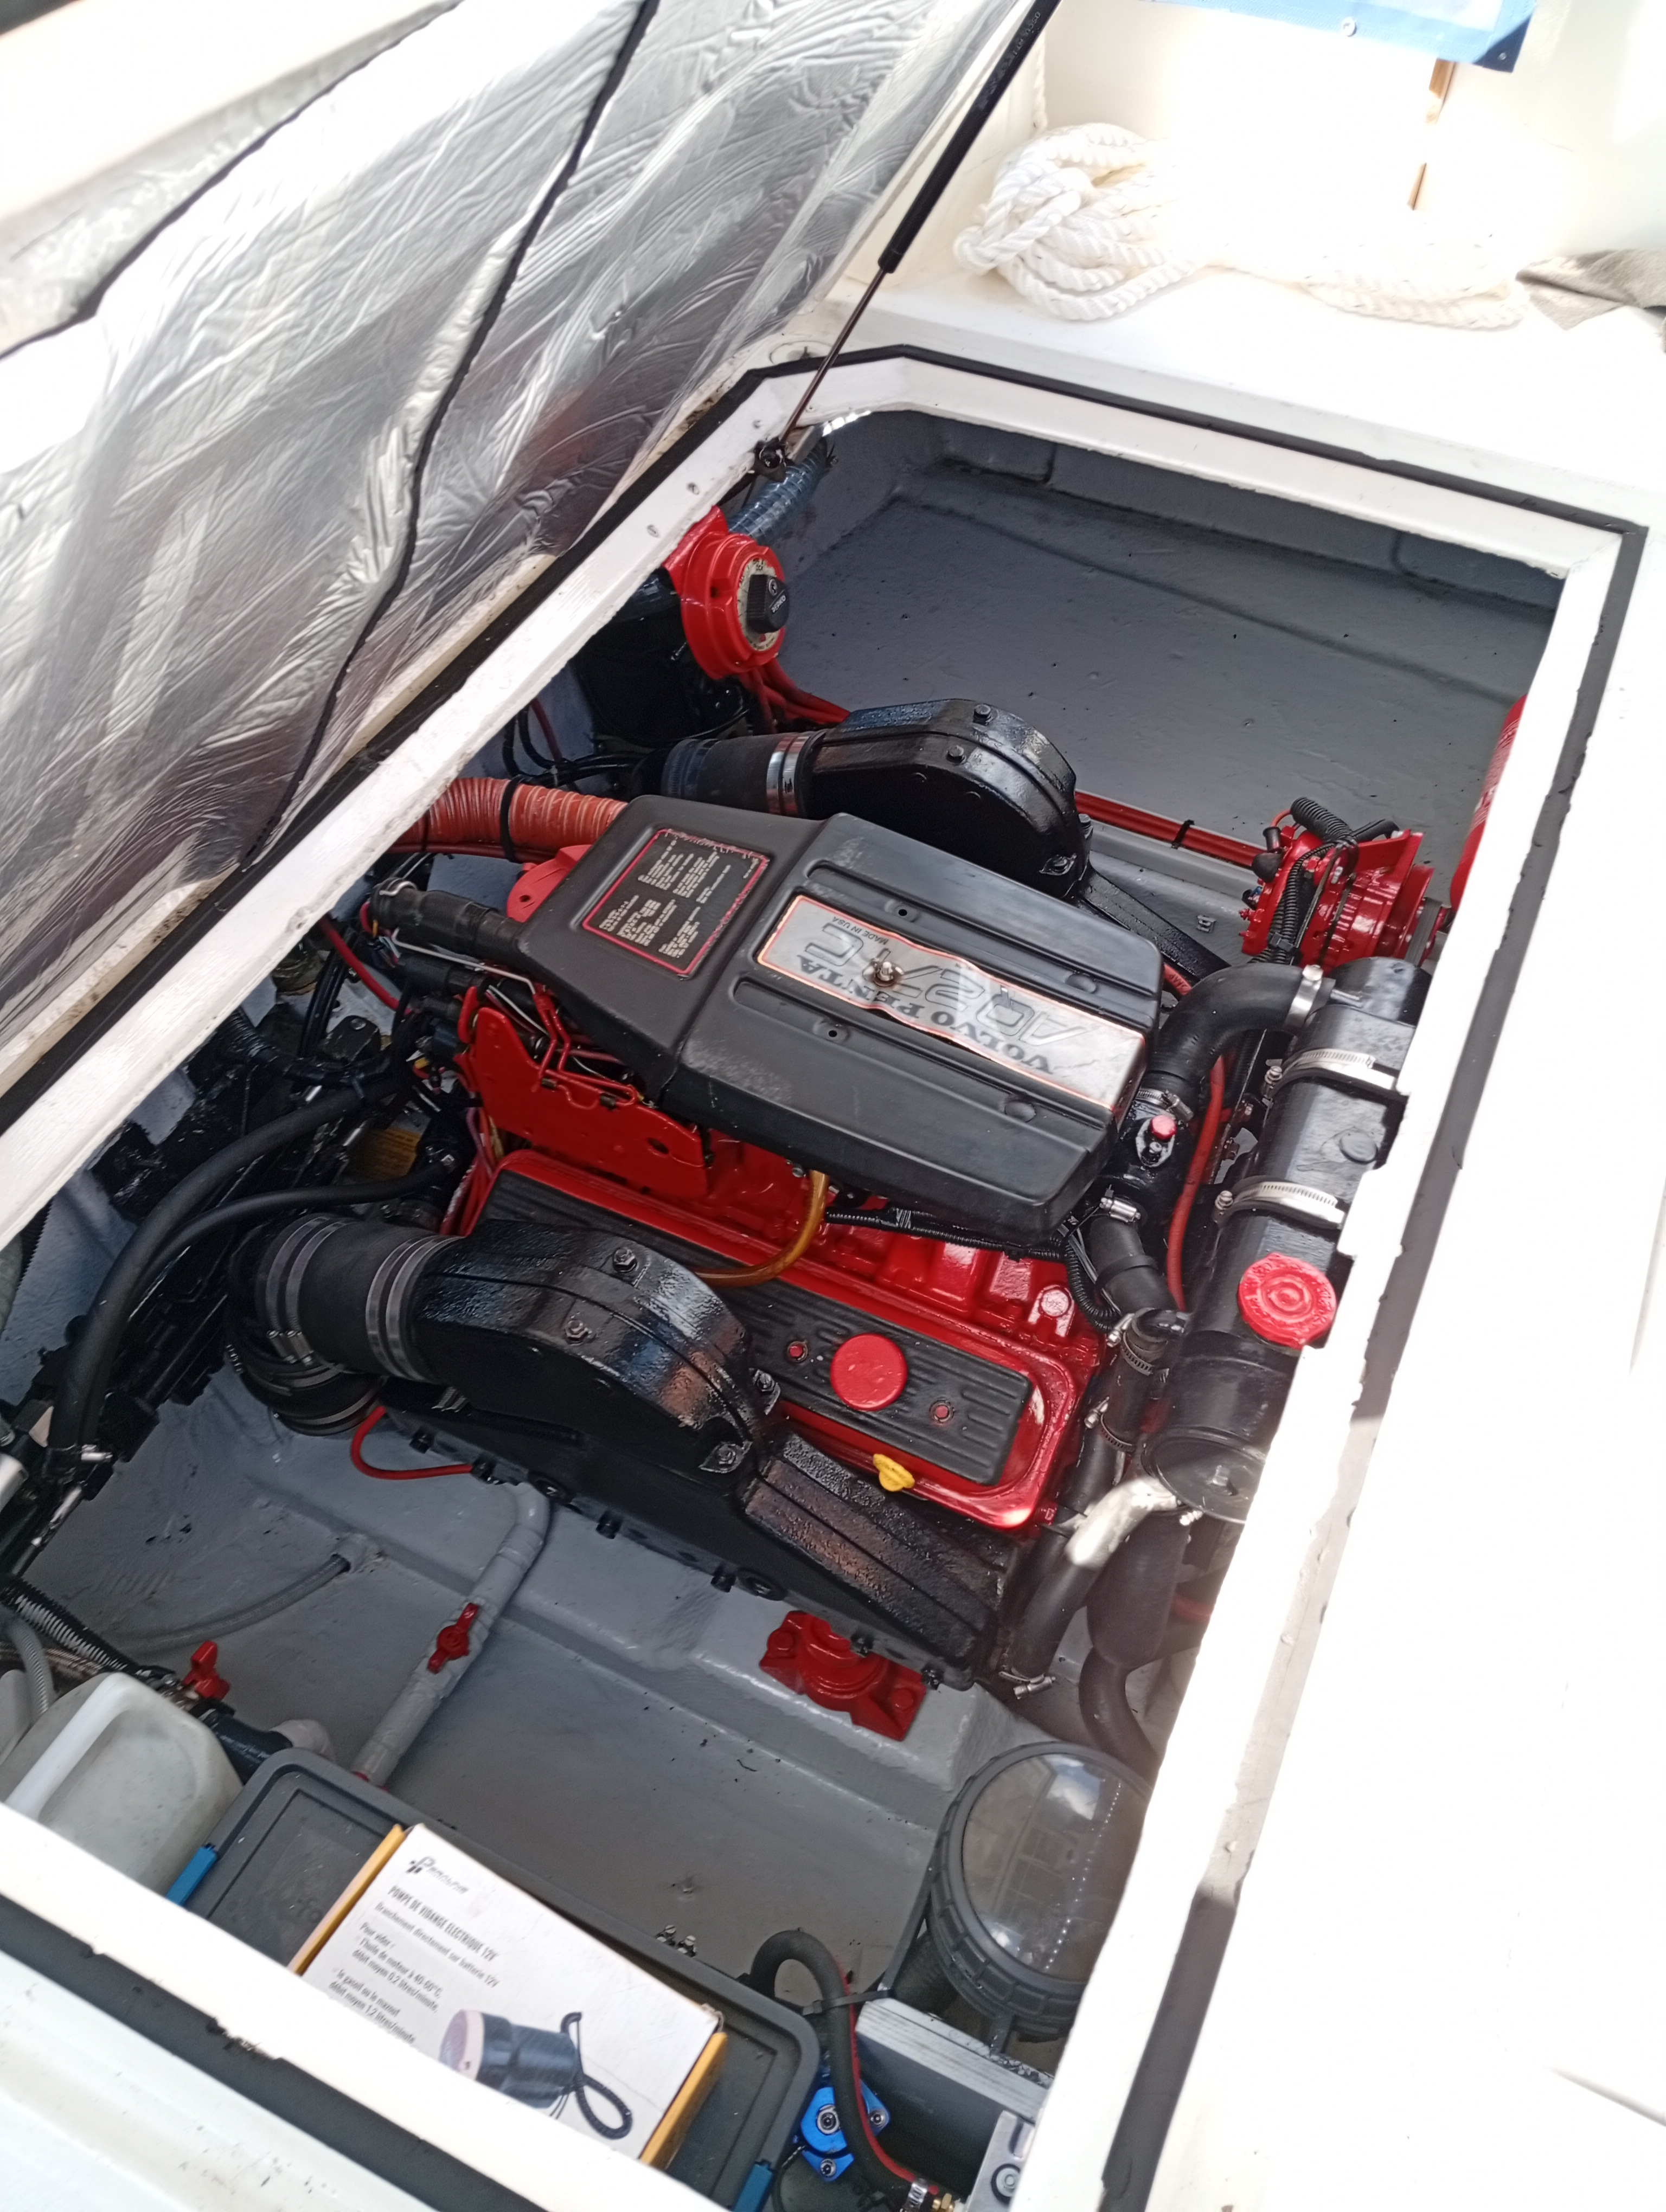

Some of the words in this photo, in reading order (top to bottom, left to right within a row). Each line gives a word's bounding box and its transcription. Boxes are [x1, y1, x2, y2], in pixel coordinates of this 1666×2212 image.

[832, 916, 851, 929] USA
[851, 925, 862, 934] IN
[862, 930, 889, 945] MADE
[796, 954, 925, 1019] PENTA
[931, 1011, 1053, 1075] VOLVO
[359, 1921, 376, 1937] Pour
[387, 1885, 413, 1906] POMPE
[408, 1899, 422, 1912] DE
[418, 1905, 448, 1929] VIDANGE
[444, 1922, 484, 1953] ELECTRIQUE
[480, 1946, 497, 1962] 12V
[374, 1901, 416, 1932] Branchement
[412, 1927, 451, 1956] directement
[447, 1952, 462, 1963] sur
[458, 1957, 485, 1979] batterie
[483, 1974, 499, 1988] 12V
[351, 1949, 370, 1964] débit
[367, 1960, 389, 1977] moyen
[377, 1950, 388, 1961] de
[385, 1957, 409, 1975] moteur
[328, 1980, 348, 1996] débit
[344, 1992, 366, 2010] moyen
[336, 1968, 345, 1979] le
[341, 1975, 365, 1991] gasoil
[360, 1987, 371, 1997] ou
[368, 1991, 378, 2002] le
[375, 1998, 401, 2017] mazout
